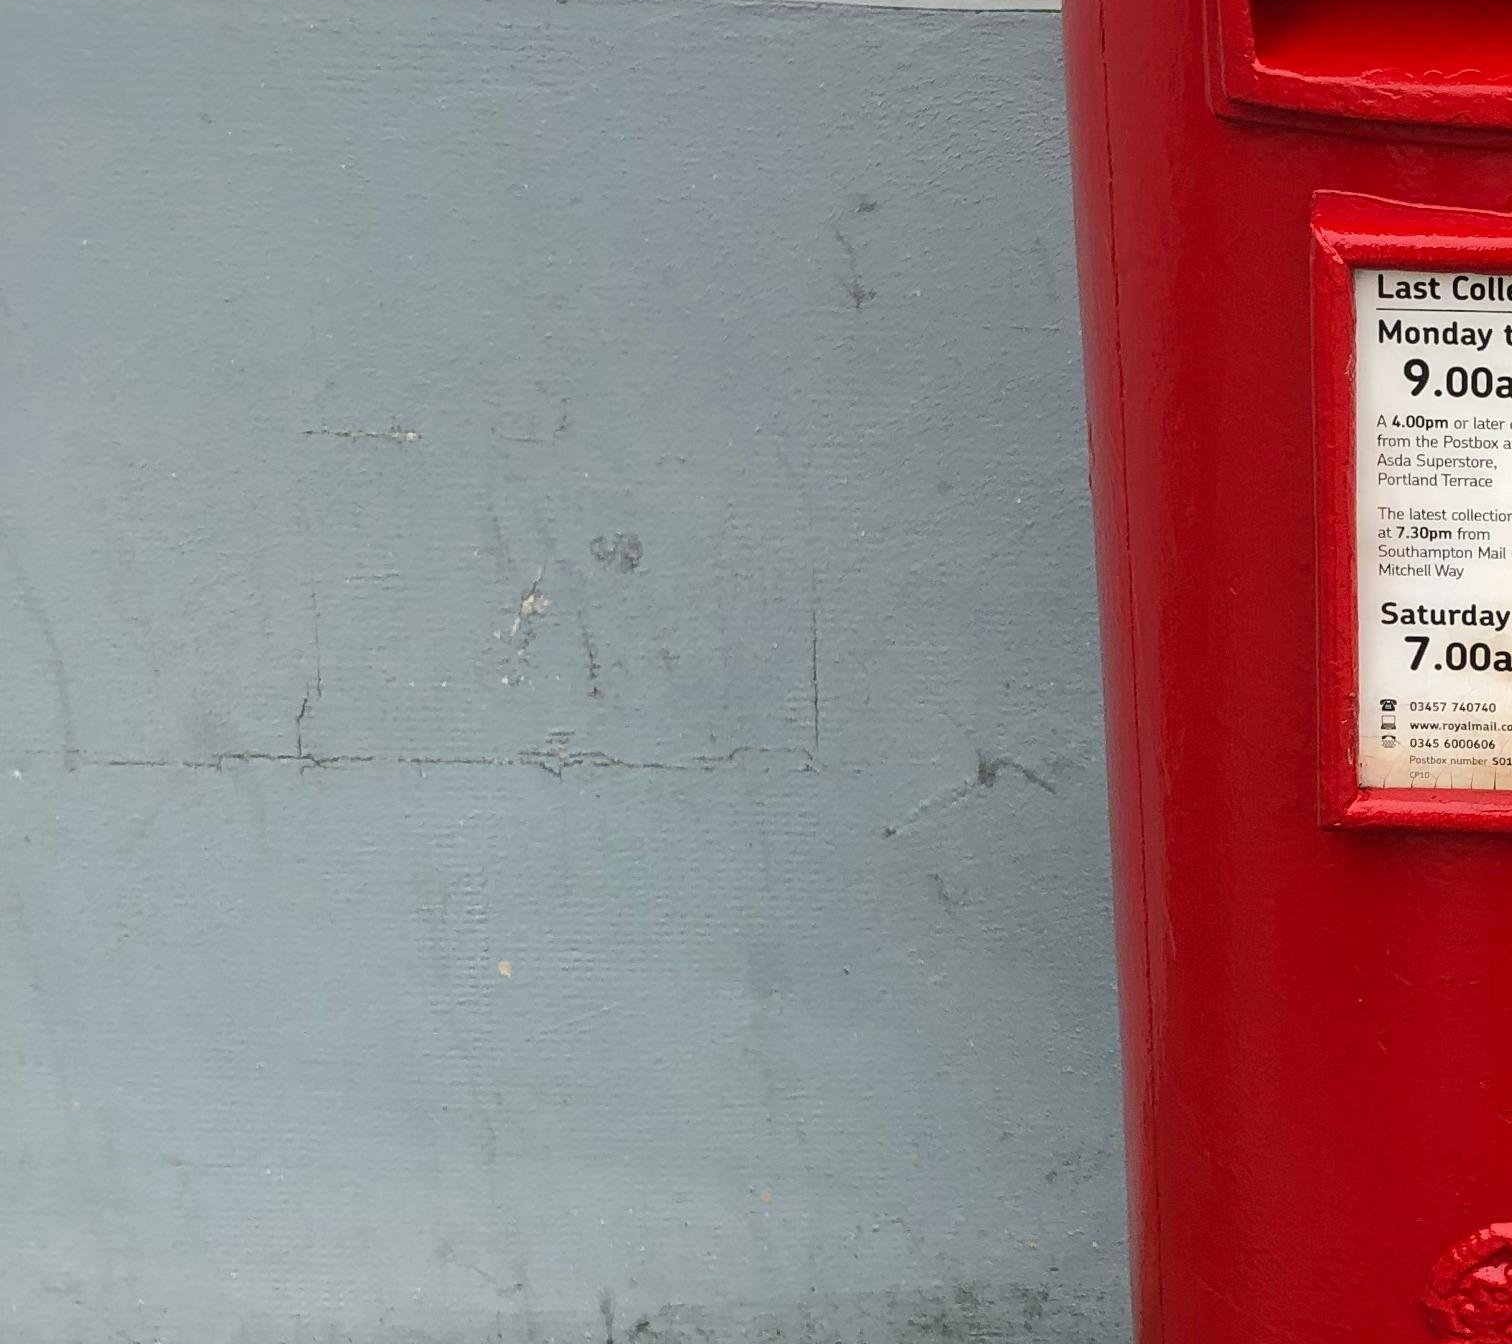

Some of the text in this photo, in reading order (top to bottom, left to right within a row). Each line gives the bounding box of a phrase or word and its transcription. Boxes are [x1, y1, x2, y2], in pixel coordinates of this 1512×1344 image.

[1377, 272, 1441, 300] Last
[1378, 318, 1493, 351] Monday
[1376, 413, 1387, 428] A
[1391, 414, 1448, 431] 4.00pm
[1453, 419, 1469, 429] or
[1473, 416, 1505, 430] later
[1376, 433, 1410, 447] from
[1415, 434, 1438, 448] the
[1443, 434, 1498, 449] Postbox
[1376, 452, 1497, 470] Asda Superstore,
[1377, 471, 1492, 487] Portland Terrace
[1377, 506, 1404, 520] The
[1409, 507, 1447, 520] latest
[1377, 525, 1490, 542] at 7.30pm from
[1377, 544, 1472, 561] Southampton
[1478, 545, 1506, 559] Mail
[1378, 562, 1464, 580] Mitchell Way
[1380, 601, 1510, 631] Saturday
[1409, 701, 1496, 712] 03457 740740
[1409, 737, 1495, 749] 0345 6000606
[1408, 755, 1447, 765] Postbox
[1448, 756, 1488, 765] number
